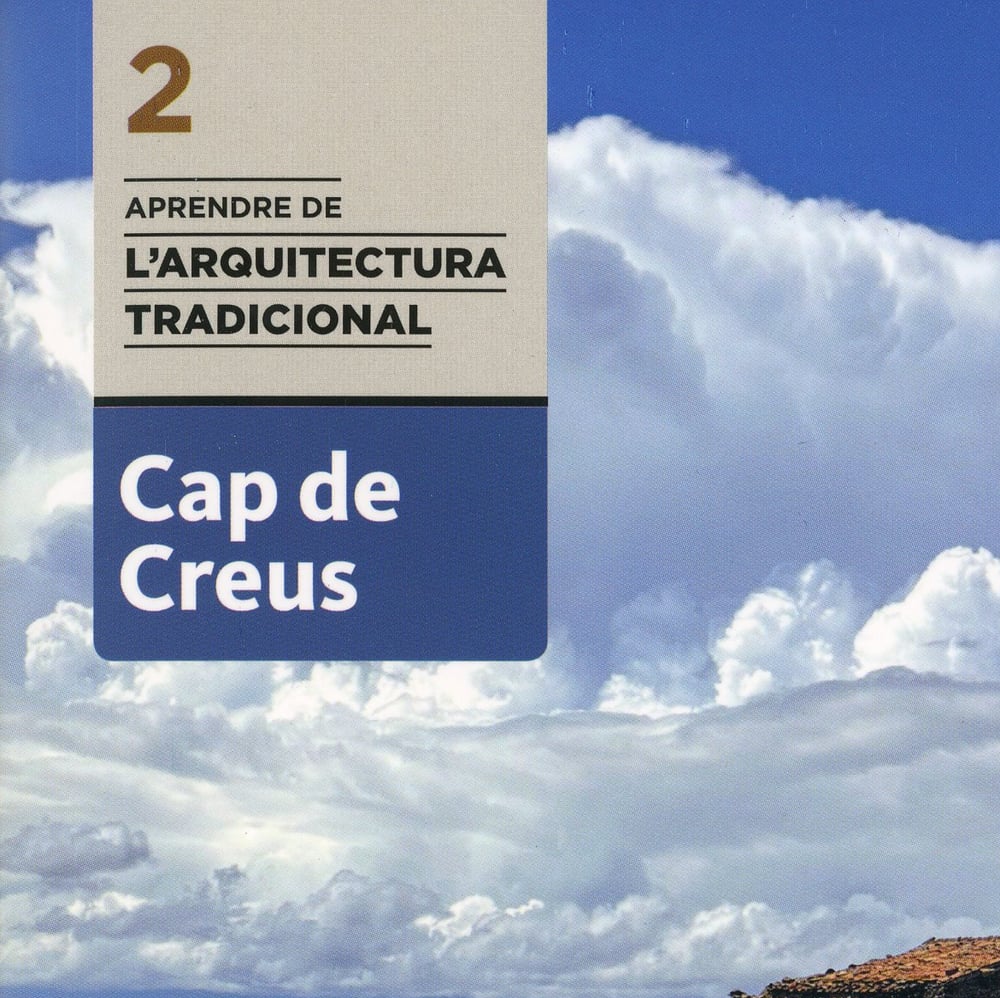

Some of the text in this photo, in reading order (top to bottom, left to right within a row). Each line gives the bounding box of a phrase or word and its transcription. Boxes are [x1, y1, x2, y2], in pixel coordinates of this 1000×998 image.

[127, 45, 192, 133] 2
[125, 196, 342, 219] APRENDRE DE
[126, 246, 507, 279] L’ARQUITECTURA
[125, 303, 433, 336] TRADICIONAL
[119, 449, 401, 542] Cap de
[120, 543, 358, 612] Creus
